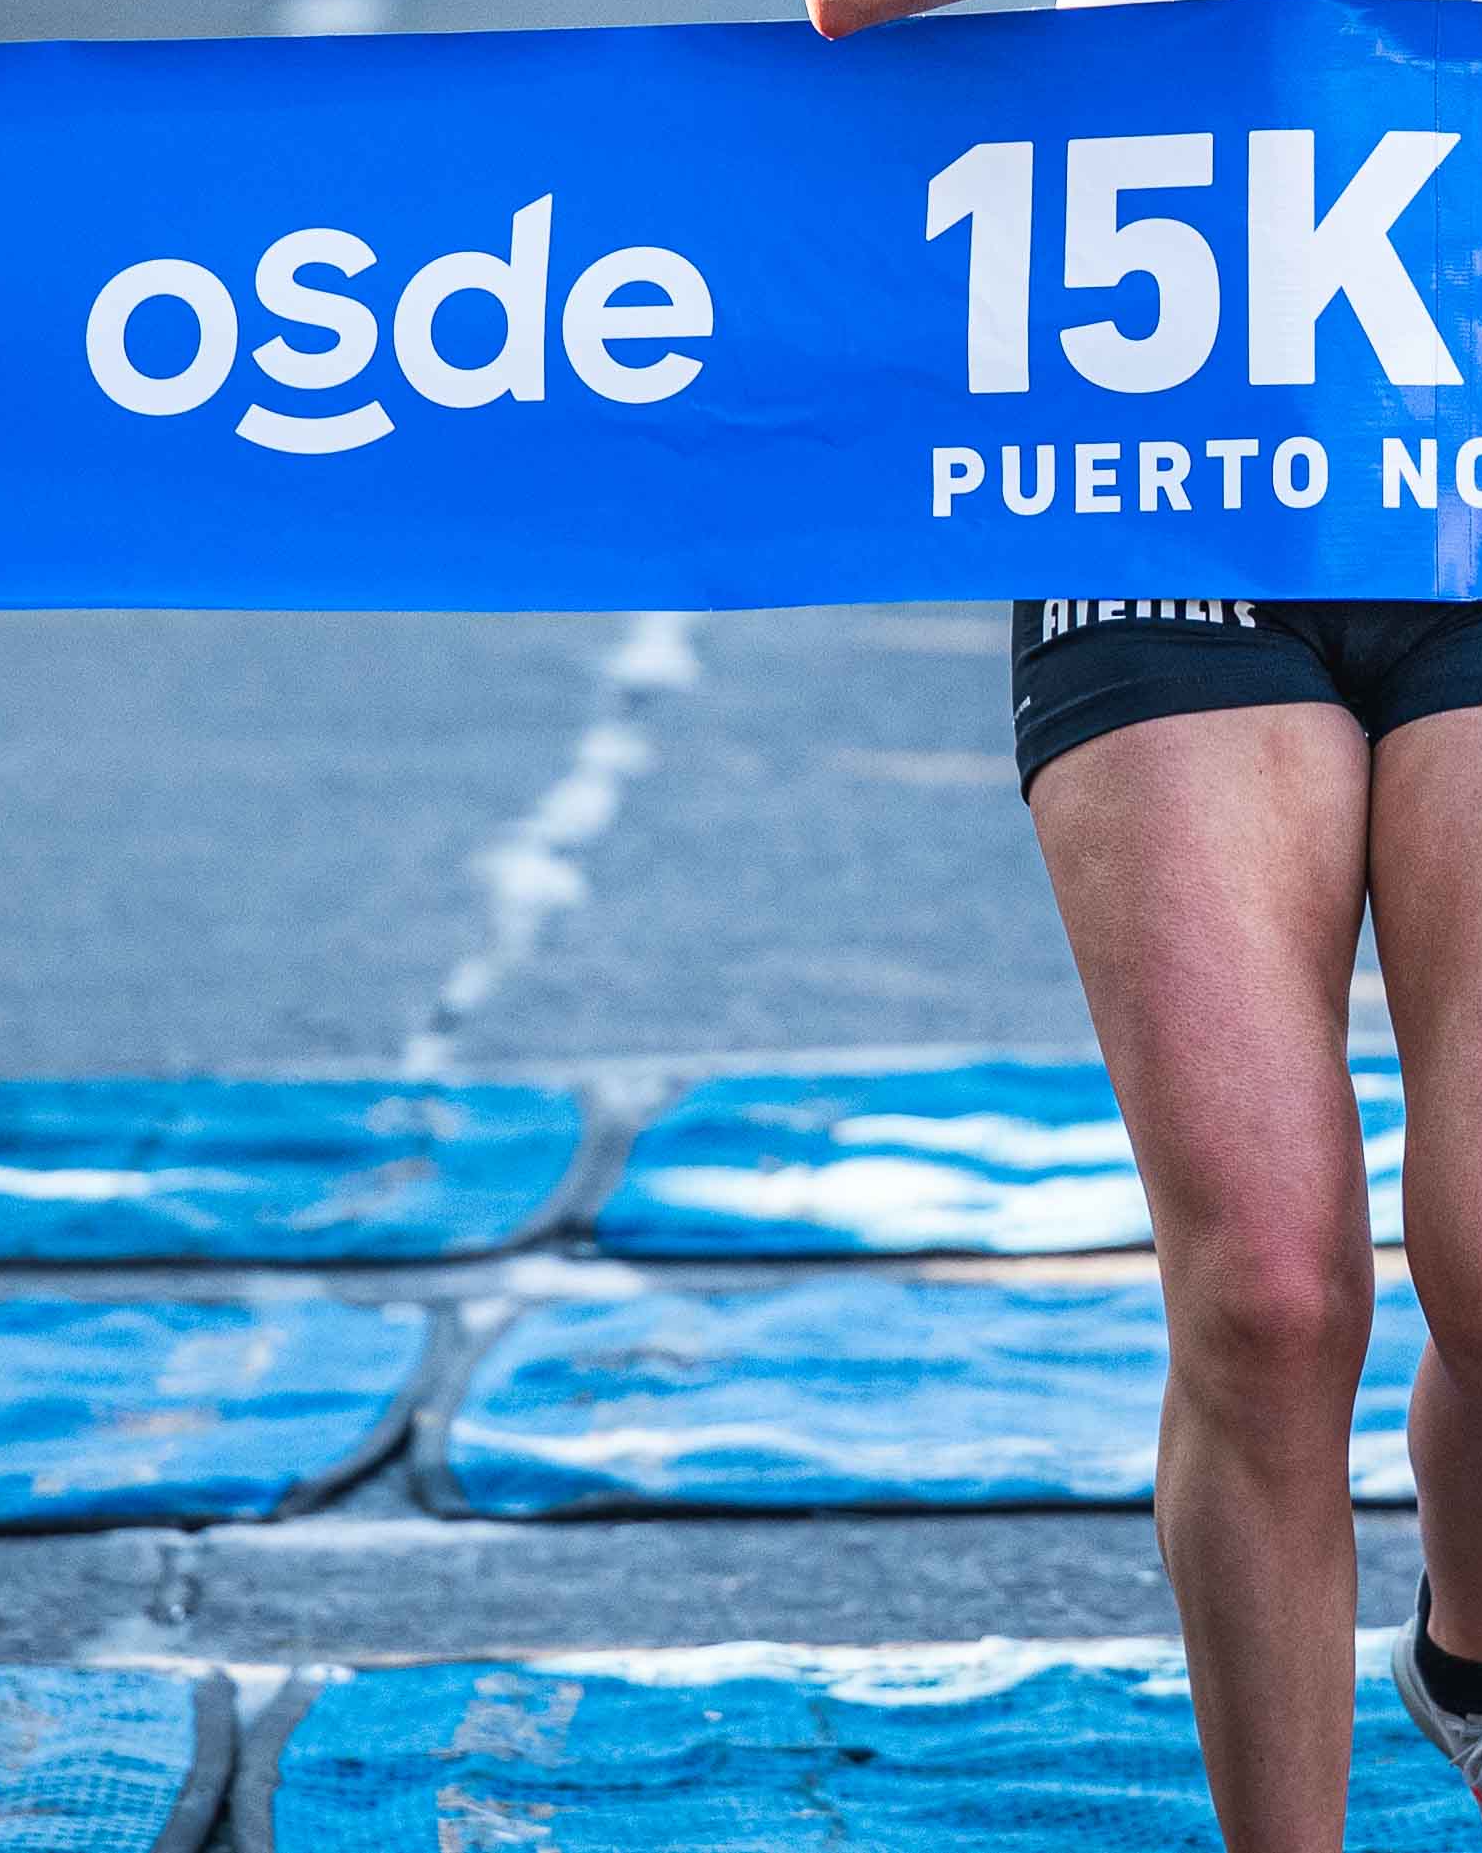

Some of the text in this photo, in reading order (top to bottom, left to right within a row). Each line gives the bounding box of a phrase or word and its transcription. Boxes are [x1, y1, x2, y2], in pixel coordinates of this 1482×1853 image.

[85, 193, 714, 418] osde
[926, 130, 1464, 394] 15K
[933, 437, 1329, 517] PUERTO
